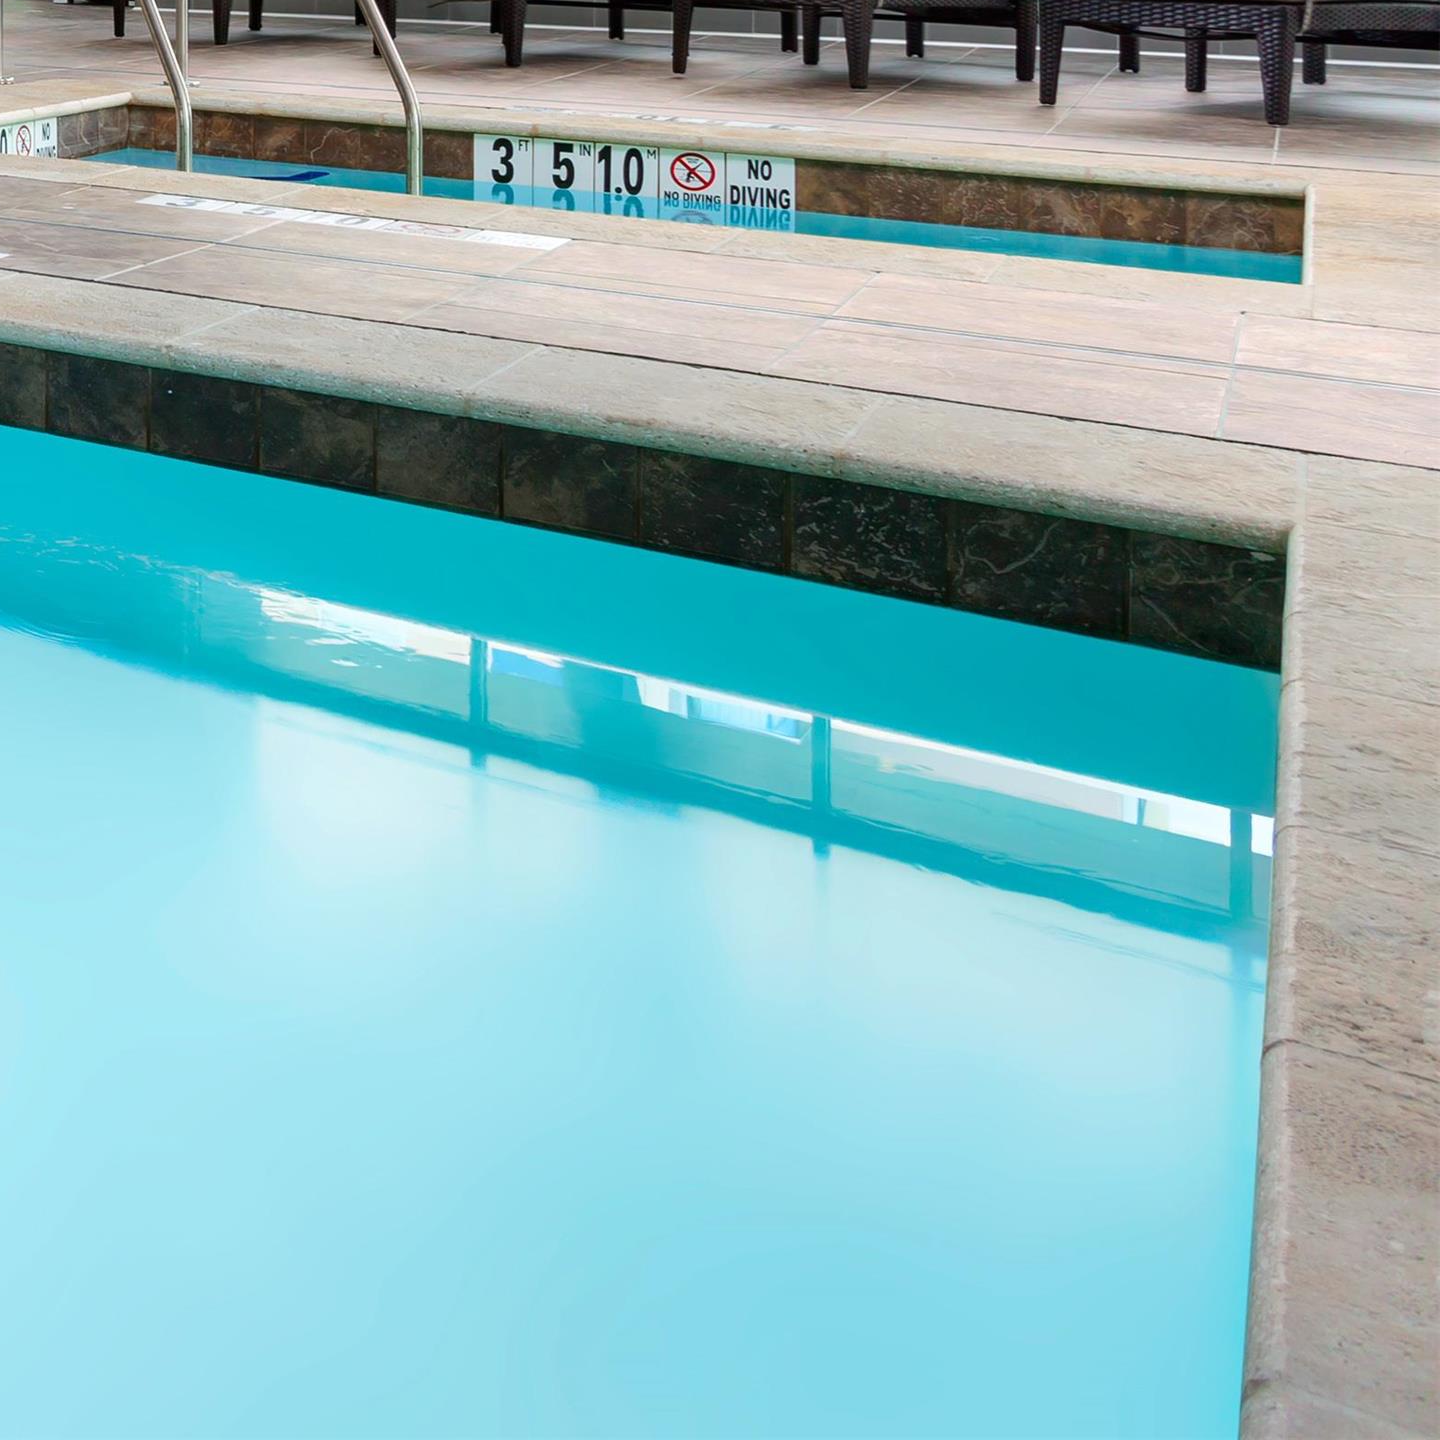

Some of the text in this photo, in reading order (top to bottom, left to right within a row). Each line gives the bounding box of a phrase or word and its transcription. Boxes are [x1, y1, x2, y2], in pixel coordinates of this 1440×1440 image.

[491, 138, 514, 184] 3
[518, 139, 529, 152] FT
[552, 142, 575, 189] 5
[579, 144, 591, 157] IN
[647, 149, 656, 160] M
[748, 159, 772, 181] NO
[664, 191, 721, 205] NO DIVING
[730, 185, 791, 209] DIVING
